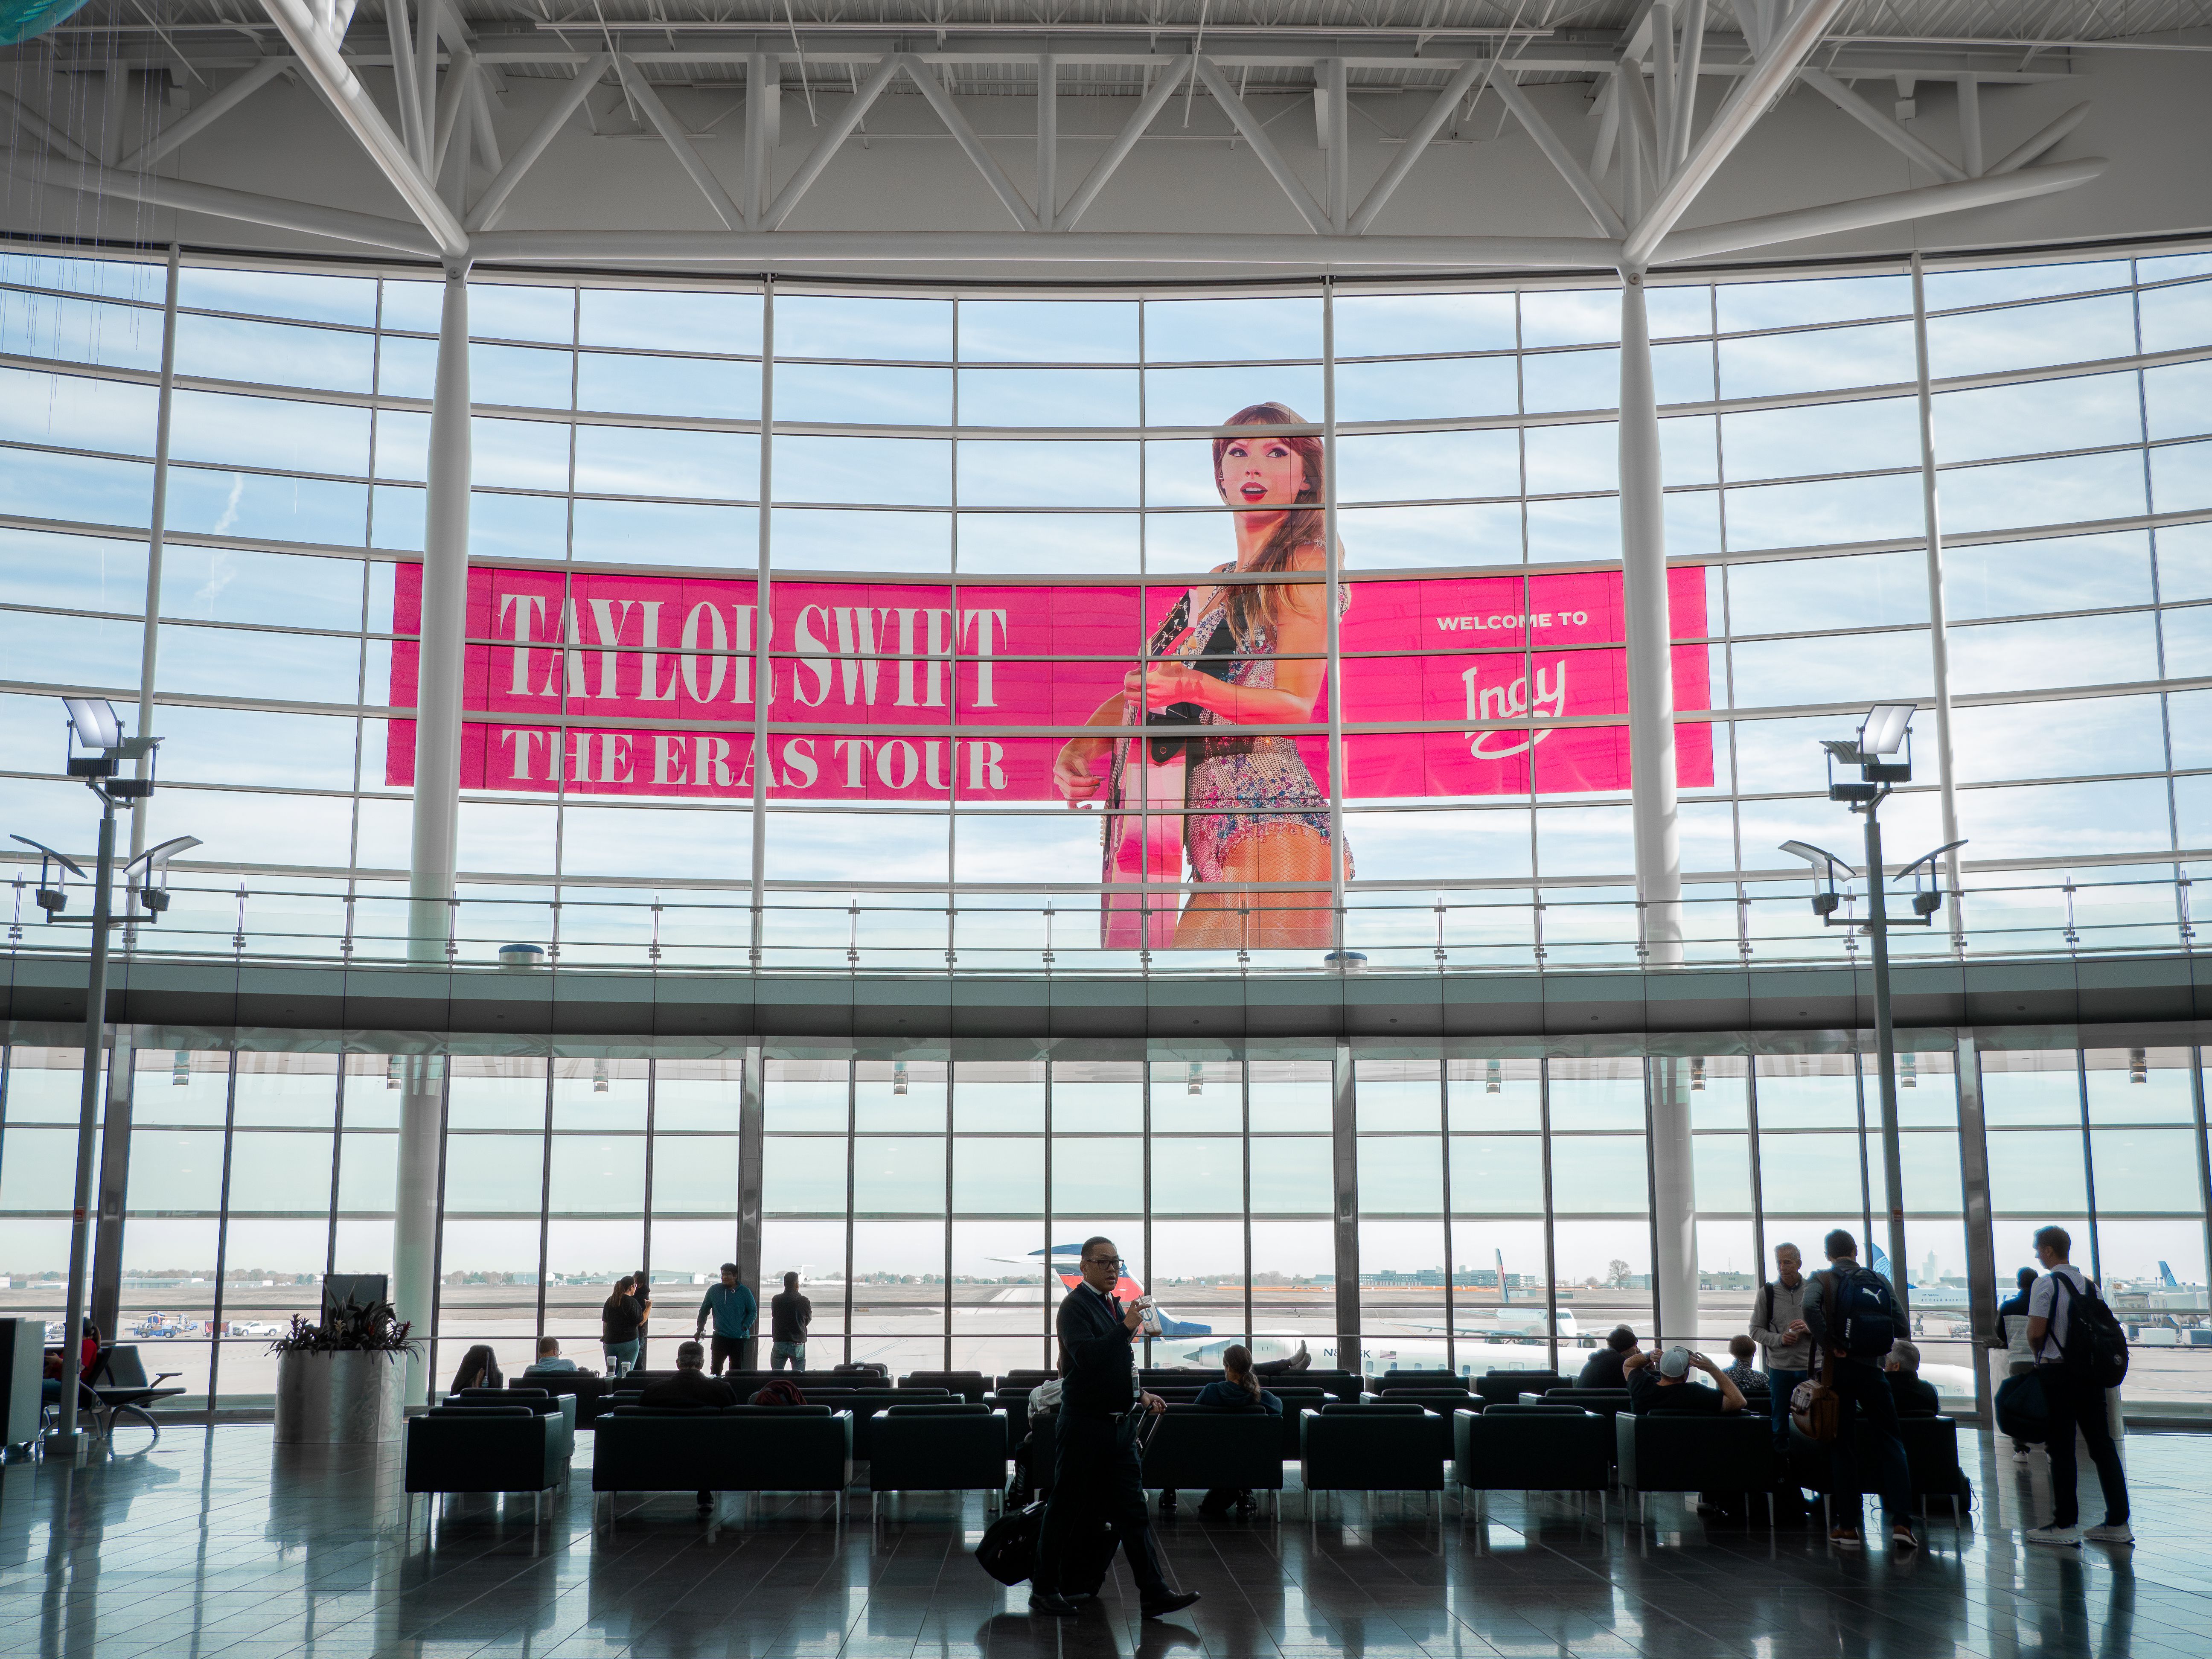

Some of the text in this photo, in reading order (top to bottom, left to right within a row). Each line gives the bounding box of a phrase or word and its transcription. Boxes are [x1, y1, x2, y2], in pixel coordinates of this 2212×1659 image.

[500, 594, 1007, 707] TAYLOR SWIFT
[1436, 611, 1588, 631] WELCOME TO
[1462, 654, 1565, 760] Indy
[502, 729, 1008, 790] THE ERAS TOUR
